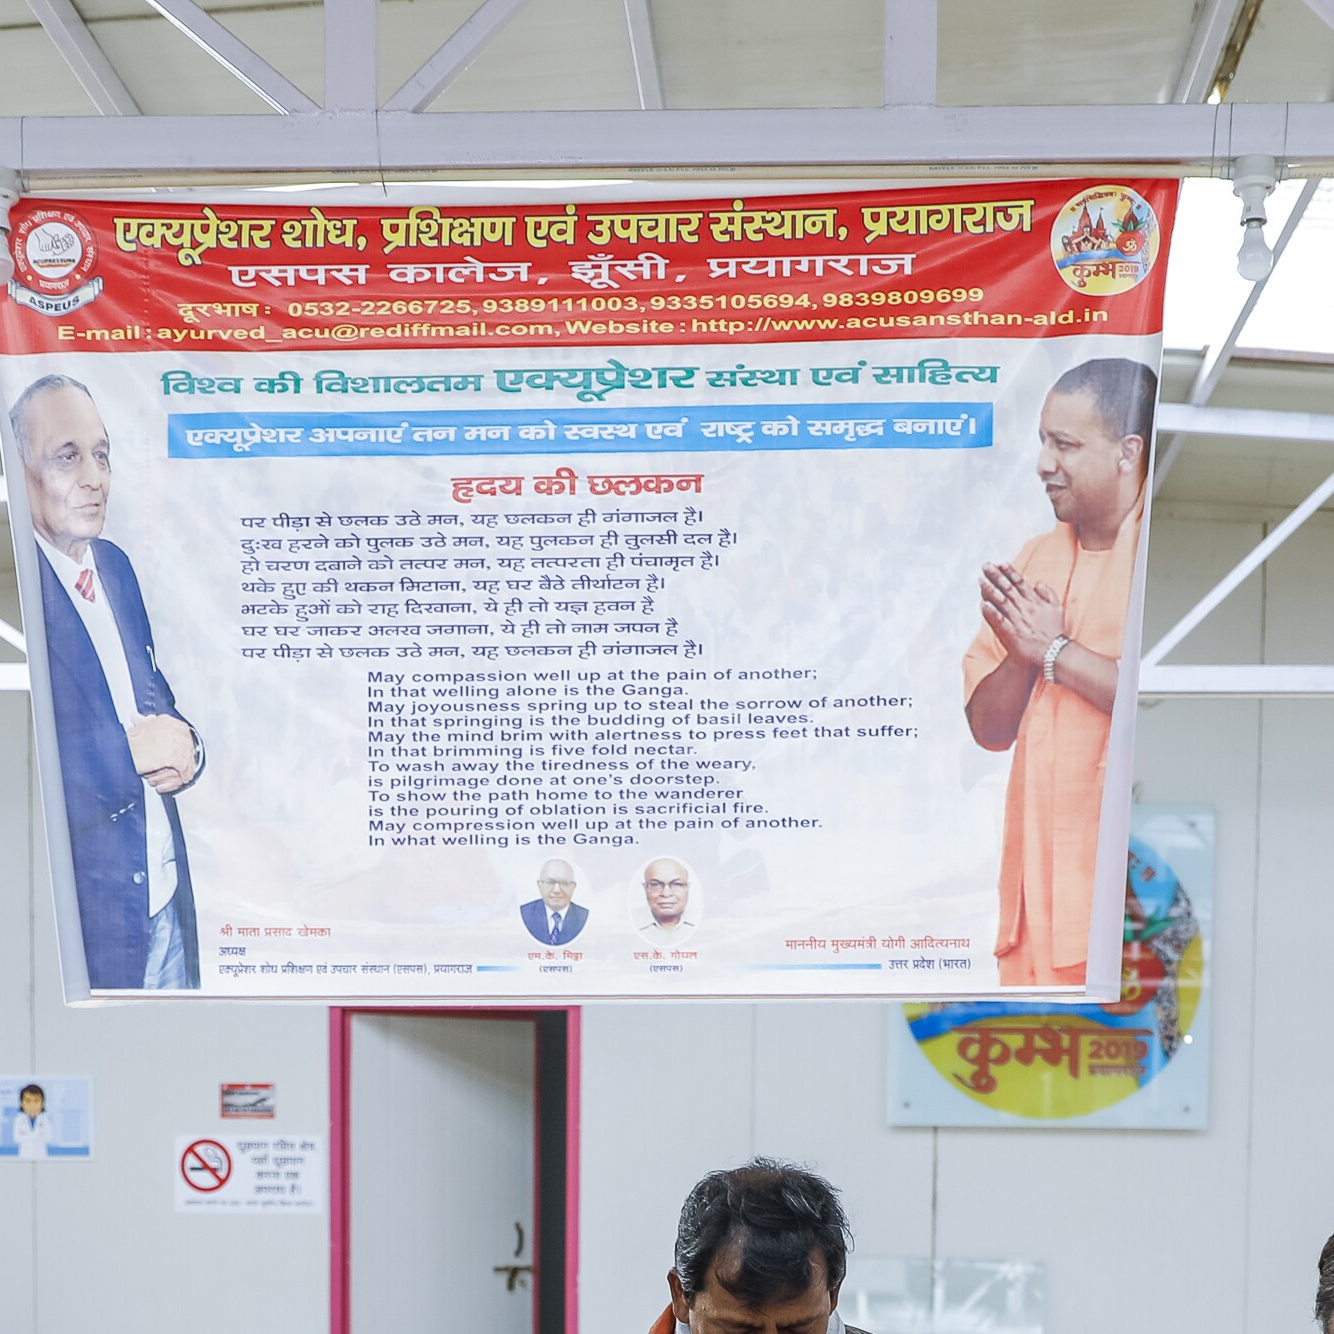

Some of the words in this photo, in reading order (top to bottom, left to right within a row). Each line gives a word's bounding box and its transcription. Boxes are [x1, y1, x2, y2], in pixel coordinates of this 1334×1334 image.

[113, 206, 276, 266] एक्यूप्रेशर
[281, 206, 368, 252] शोध,
[380, 205, 517, 255] प्रशिक्षण
[524, 203, 579, 248] एवं
[586, 212, 704, 245] उपचार
[709, 199, 849, 243] संस्थान,
[861, 199, 1036, 244] प्रयागराज
[227, 263, 371, 287] एसपस
[706, 253, 916, 279] प्रयागराज
[1071, 261, 1116, 288] कुम्भ
[1118, 265, 1140, 273] 2019
[29, 295, 80, 311] ASPEUS
[177, 302, 259, 324] दूरभाष
[286, 299, 479, 317] 0532-2266725,
[481, 296, 647, 314] 9389111003,
[649, 292, 819, 311] 9335105694,
[821, 287, 985, 308] 9839809699
[156, 321, 561, 343] ayurved_acu@rediffmail.com,
[691, 308, 1108, 336] http://www.acusansthan-ald.in
[160, 370, 244, 396] विश्व
[253, 370, 304, 394] की
[313, 369, 485, 394] विशालतम
[493, 358, 701, 403] एक्यूप्रेशर
[705, 363, 801, 388] संस्था
[809, 360, 868, 387] एवं
[871, 357, 1001, 386] साहित्य
[184, 422, 304, 452] एक्यूप्रेशर
[308, 422, 409, 444] अपनाएं
[411, 426, 458, 442] तन
[463, 425, 512, 441] मन
[517, 419, 557, 441] को
[563, 423, 639, 440] स्वस्थ
[644, 417, 689, 440] एवं
[700, 421, 756, 444] राष्ट्र
[760, 415, 801, 436] को
[806, 419, 886, 442] समृद्ध
[893, 413, 976, 436] बनाएं।
[450, 476, 526, 504] हृदय
[532, 466, 579, 496] की
[586, 473, 706, 497] छलकन
[240, 517, 267, 529] पर
[271, 512, 311, 532] पीड़ा
[314, 510, 334, 528] से
[336, 515, 390, 527] छलक
[394, 509, 422, 527] उठे
[426, 514, 465, 527] मन,
[469, 514, 499, 529] यह
[503, 513, 573, 525] छलकन
[576, 507, 598, 528] ही
[601, 508, 679, 524] गंगाजल
[682, 505, 703, 527] है।
[367, 670, 405, 686] May
[411, 669, 527, 685] compassion
[533, 668, 570, 681] well
[577, 671, 601, 684] up
[607, 668, 624, 680] at
[630, 668, 660, 680] the
[667, 667, 707, 683] pain
[713, 667, 732, 679] of
[738, 666, 817, 682] another;
[368, 699, 405, 715] May
[412, 699, 520, 715] joyousness
[527, 698, 587, 714] spring
[594, 701, 618, 714] up
[623, 697, 642, 710] to
[648, 697, 693, 710] steal
[699, 697, 729, 709] the
[735, 699, 803, 708] sorrow
[808, 695, 827, 708] of
[833, 694, 913, 710] another;
[368, 729, 405, 745] May
[411, 729, 441, 741] the
[447, 728, 494, 741] mind
[500, 728, 543, 741] brim
[549, 728, 588, 740] with
[595, 727, 682, 740] alertness
[688, 726, 707, 739] to
[713, 729, 766, 742] press
[772, 725, 808, 738] feet
[813, 725, 850, 737] that
[857, 724, 918, 740] suffer;
[368, 774, 384, 786] is
[390, 773, 490, 789] pilgrimage
[496, 773, 543, 785] done
[549, 772, 567, 785] at
[572, 772, 623, 785] one’s
[629, 771, 720, 787] doorstep.
[368, 788, 390, 801] To
[396, 788, 447, 801] show
[452, 788, 482, 800] the
[488, 788, 529, 804] path
[536, 787, 588, 800] home
[594, 787, 613, 799] to
[618, 787, 648, 799] the
[654, 786, 744, 798] wanderer
[219, 924, 233, 937] श्री
[237, 927, 260, 937] माता
[264, 927, 293, 938] प्रसाद
[298, 925, 331, 937] खेमका
[219, 946, 246, 956] अध्यक्ष
[785, 935, 826, 950] माननीय
[831, 936, 877, 953] मुख्यमंत्री
[881, 935, 905, 949] योगी
[910, 935, 970, 949] आदित्यनाथ
[260, 961, 278, 974] शोध
[281, 961, 313, 975] प्रशिक्षण
[316, 962, 328, 974] एवं
[330, 964, 357, 975] उपचार
[434, 964, 473, 975] प्रयागराज
[888, 959, 908, 970] उत्तर
[912, 956, 934, 970] प्रदेश
[938, 958, 971, 970] (भारत)
[951, 1025, 1080, 1094] कुम्भ
[1088, 1039, 1148, 1060] 2019
